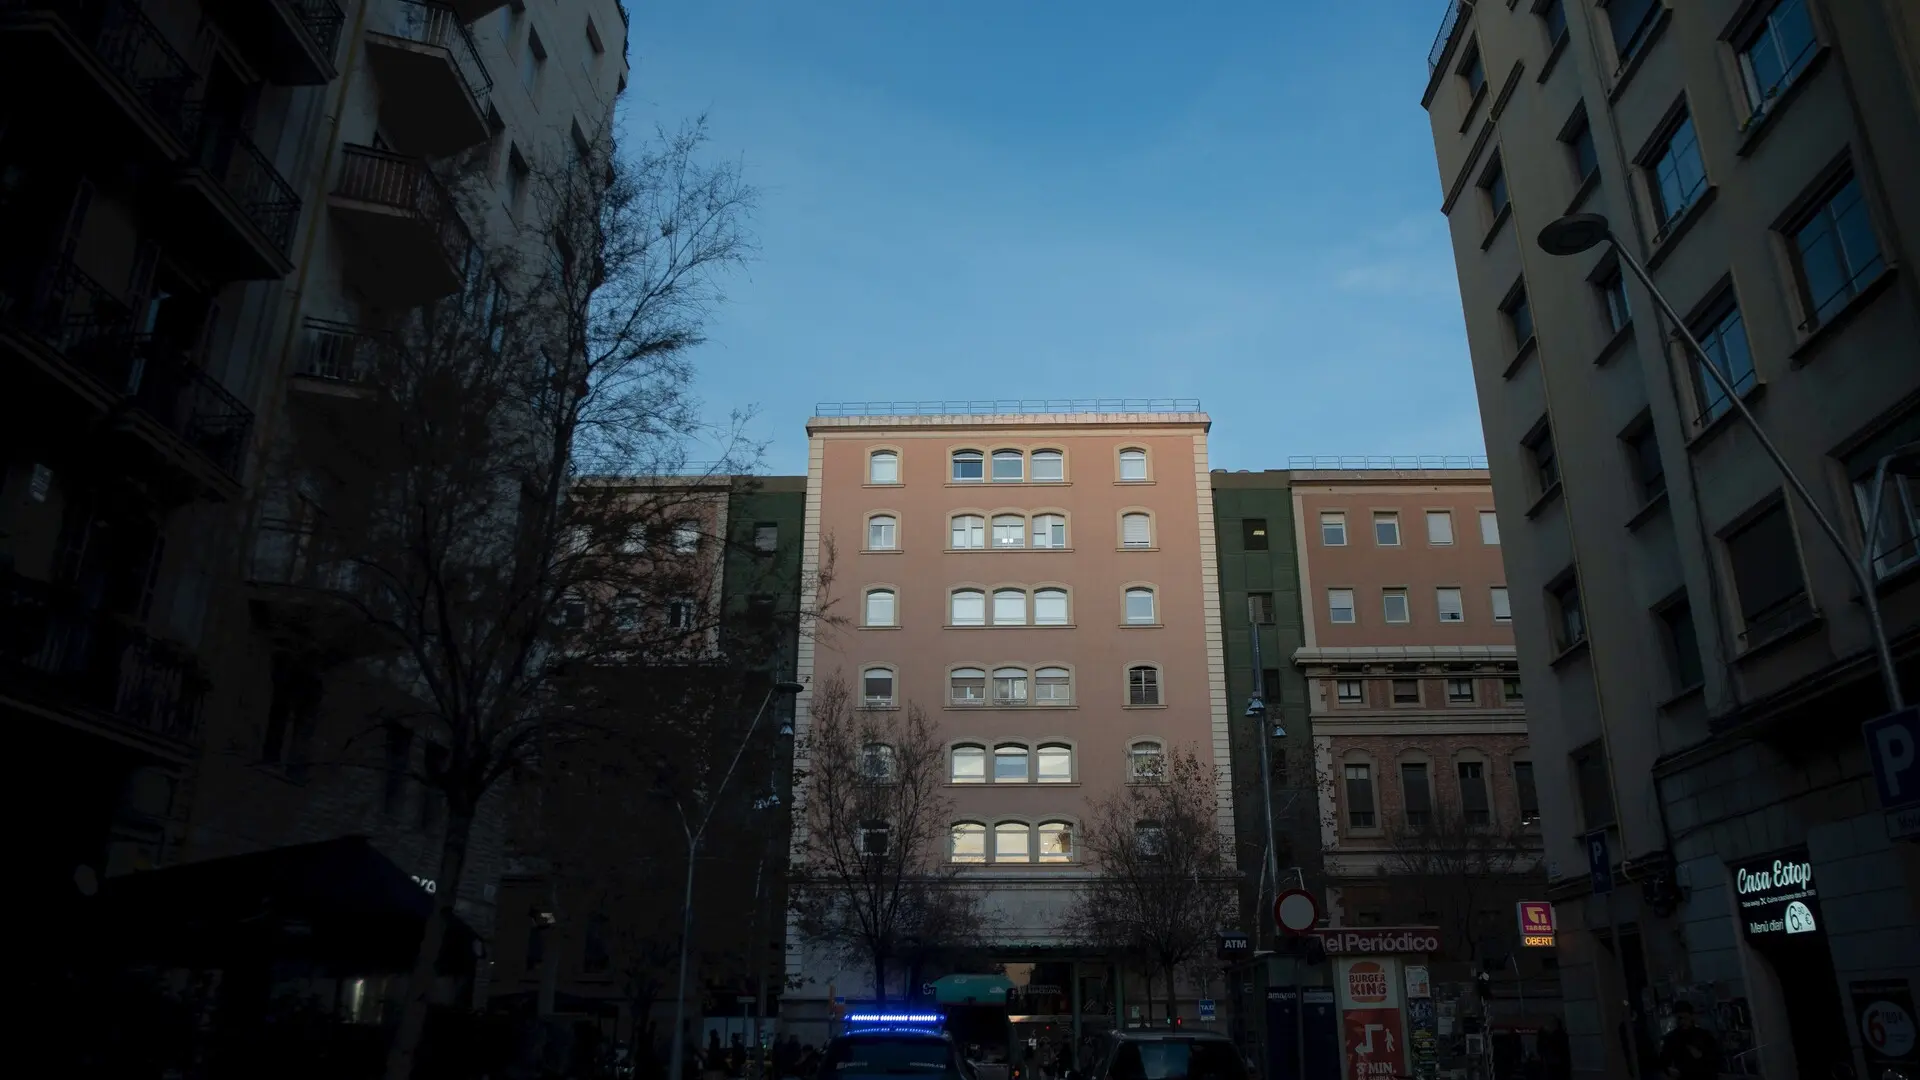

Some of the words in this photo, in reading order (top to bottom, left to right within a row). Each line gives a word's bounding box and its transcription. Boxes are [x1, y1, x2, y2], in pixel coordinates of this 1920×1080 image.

[1875, 723, 1916, 798] P
[1591, 840, 1603, 865] P
[1737, 868, 1772, 894] Casa
[1773, 860, 1812, 890] Estop
[1224, 939, 1247, 949] ATM
[1326, 933, 1343, 952] el
[1345, 932, 1438, 952] Periódico
[1525, 937, 1553, 946] OBERT
[1349, 974, 1386, 983] BURGER
[1350, 983, 1387, 995] KING
[1267, 991, 1296, 1001] amazon
